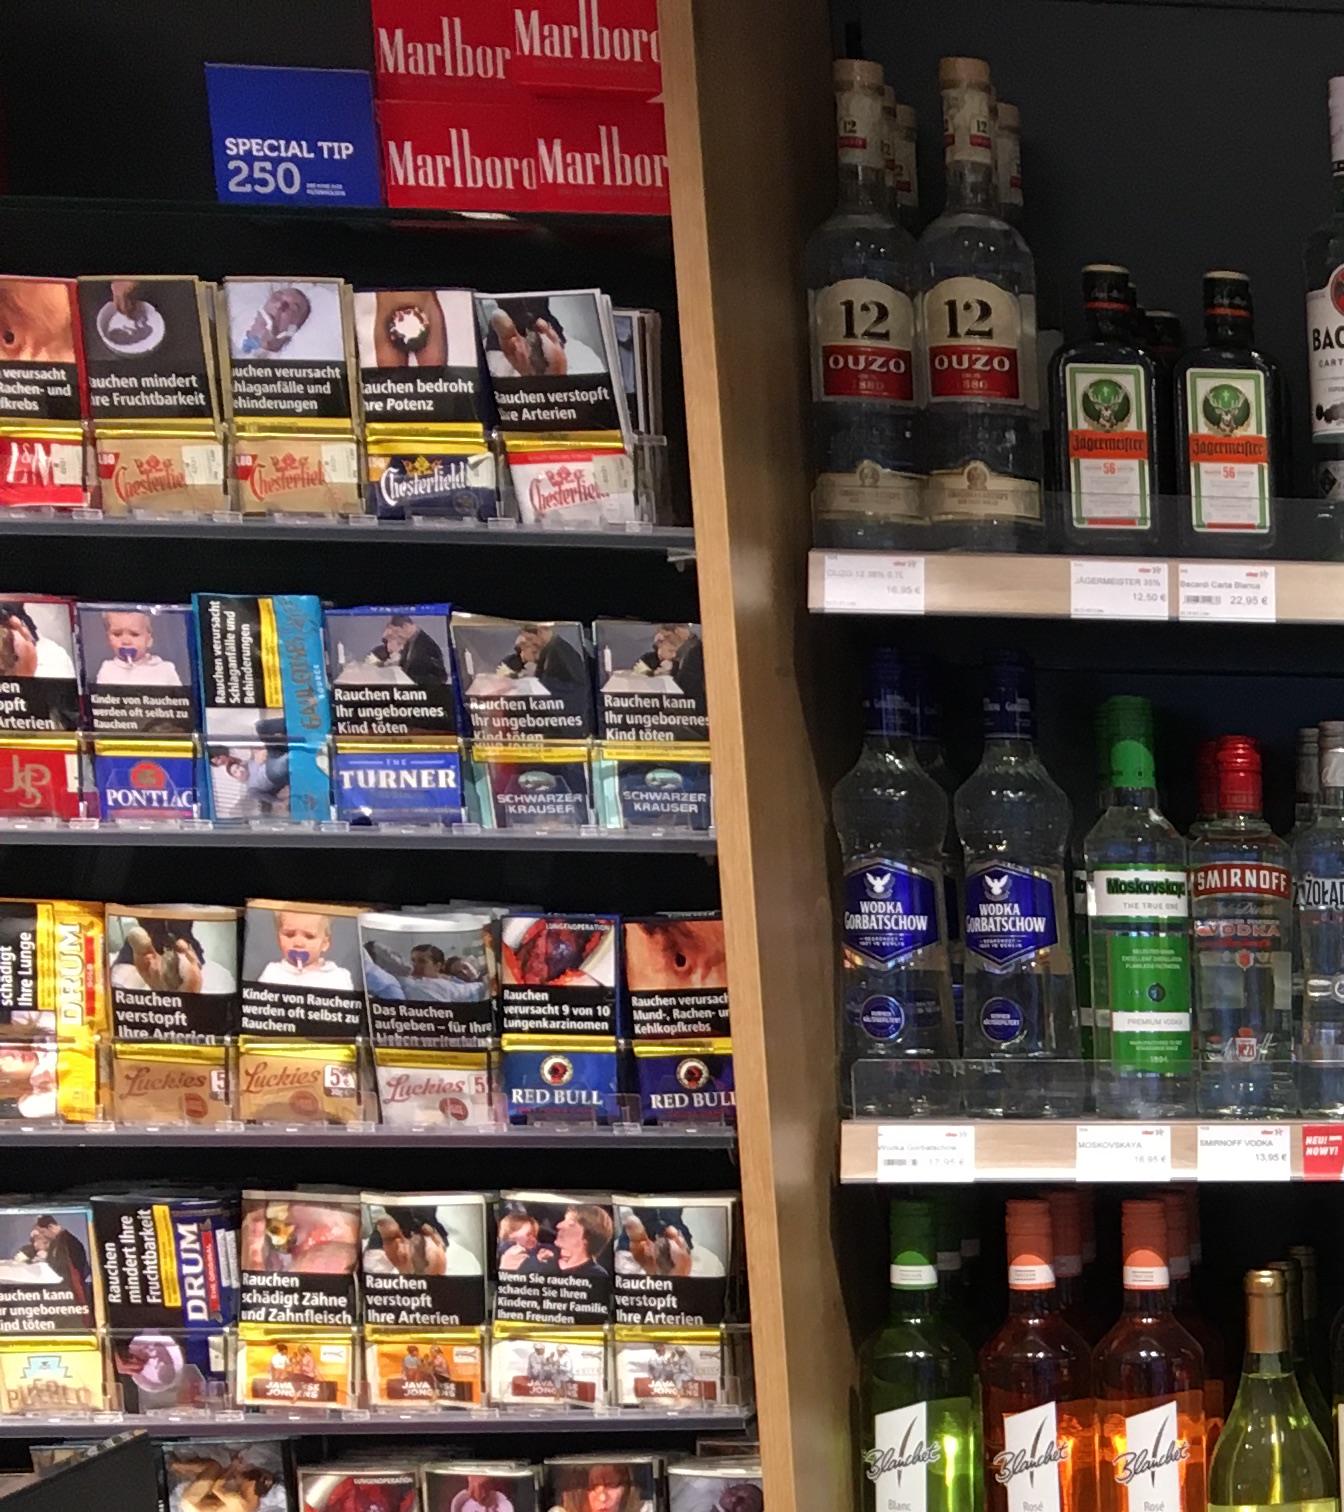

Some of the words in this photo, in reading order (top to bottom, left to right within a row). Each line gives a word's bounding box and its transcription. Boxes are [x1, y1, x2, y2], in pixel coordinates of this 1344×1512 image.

[225, 138, 314, 160] SPECIAL
[318, 141, 354, 160] TIP
[538, 125, 668, 189] Marlbor
[387, 128, 537, 191] Marlboro
[227, 160, 301, 196] 250
[840, 299, 891, 340] 12
[944, 299, 993, 339] 12
[829, 353, 906, 374] OUZO
[935, 354, 1010, 372] OUZO
[276, 365, 341, 381] verursacht
[141, 375, 198, 389] mindert
[417, 379, 474, 393] bedroht
[112, 391, 205, 407] Fruchtbarkeit
[387, 397, 434, 412] Potenz
[1102, 462, 1116, 475] 56
[380, 460, 466, 506] Chesterfield
[604, 695, 658, 708] Rauchen
[662, 696, 696, 709] kann
[605, 712, 622, 724] Ihr
[605, 728, 636, 741] Kind
[640, 729, 674, 742] töten
[338, 769, 457, 790] TURNER
[107, 788, 195, 808] PONTIAC
[623, 791, 707, 803] SCHWARZER
[634, 803, 698, 814] KRAUSER
[1197, 867, 1289, 891] SMIRNOFF
[860, 901, 903, 914] WODKA
[1123, 902, 1138, 910] THE
[1142, 902, 1162, 910] TRUE
[844, 914, 928, 931] GORBATSCHOW
[59, 923, 84, 1026] DRUM
[243, 987, 279, 1002] Kinder
[282, 993, 304, 1004] von
[307, 994, 362, 1009] Rauchern
[242, 1004, 284, 1018] werden
[287, 1005, 305, 1019] oft
[308, 1007, 341, 1022] selbst
[344, 1013, 359, 1024] zu
[503, 1004, 558, 1016] verursacht
[561, 1004, 569, 1016] 9
[571, 1006, 593, 1017] von
[597, 1005, 610, 1017] 10
[242, 1017, 296, 1033] Rauchern
[503, 1018, 609, 1032] Lungenkarzinomen
[243, 1062, 322, 1094] Luckies
[511, 1088, 549, 1104] RED
[554, 1089, 603, 1105] BULL
[1305, 1135, 1328, 1145] NEU!
[177, 1223, 208, 1321] DRUM
[243, 1273, 299, 1288] Rauchen
[242, 1292, 297, 1307] schädigt
[302, 1292, 347, 1307] Zähne
[269, 1308, 352, 1324] Zahnfleisch
[865, 1440, 941, 1482] Blanchet
[1113, 1440, 1190, 1484] Blanchet
[888, 1499, 912, 1512] Blanc
[1022, 1500, 1044, 1512] Rosé
